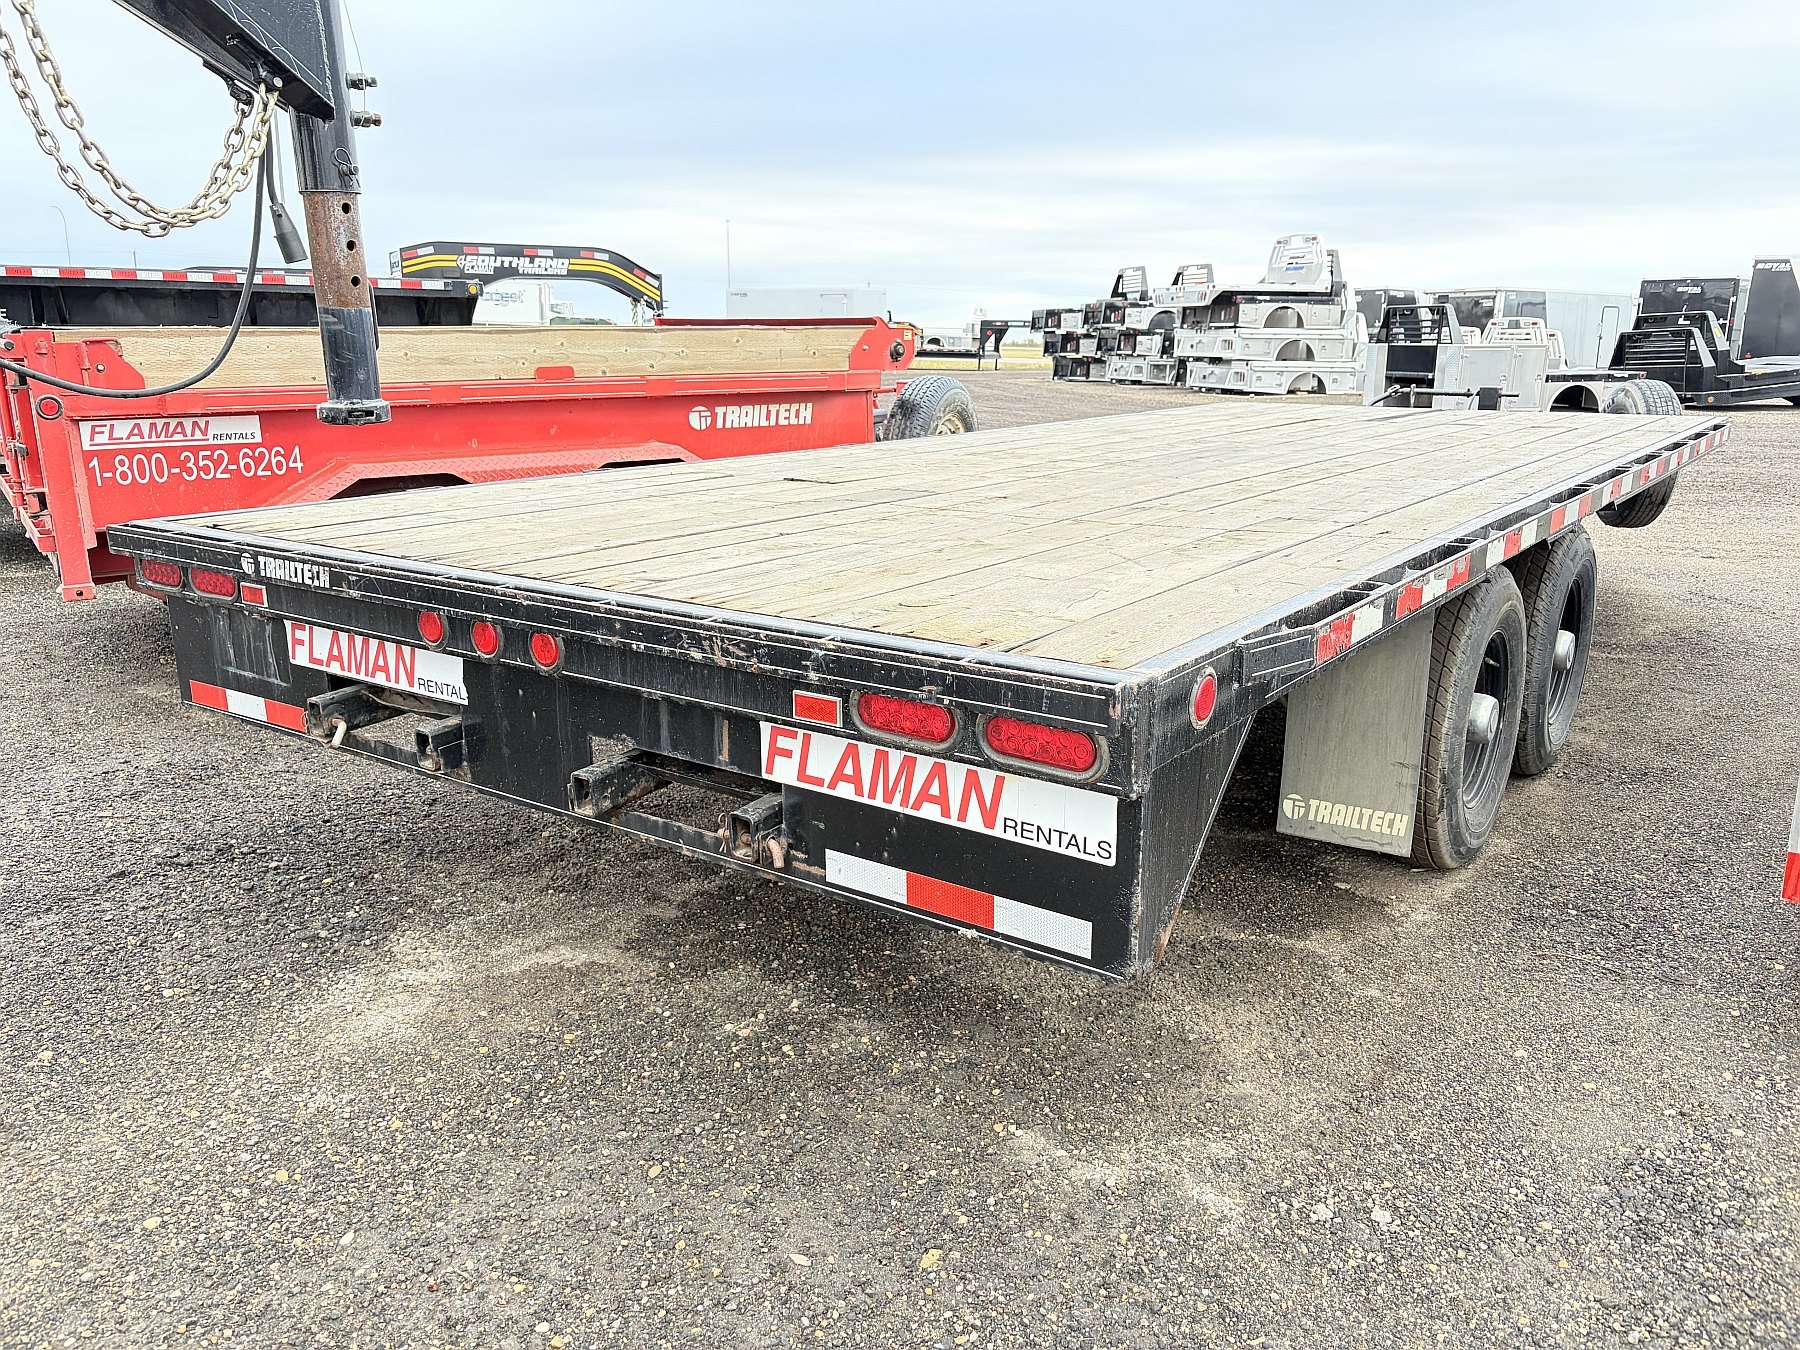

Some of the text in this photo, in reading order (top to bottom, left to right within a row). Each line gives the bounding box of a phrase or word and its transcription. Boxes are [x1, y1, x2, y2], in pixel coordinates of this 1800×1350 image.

[465, 256, 569, 268] SOUTHLAND
[89, 419, 256, 442] FLAMAN RENTALS
[714, 402, 813, 429] TRAILTECH
[88, 445, 304, 487] 1-800-352-6264
[257, 555, 330, 589] TRAILTECH
[289, 621, 468, 701] FLAMAN RENTAL
[765, 725, 1113, 861] FLAMAN RENTALS
[1307, 798, 1409, 837] TRAILTECH
